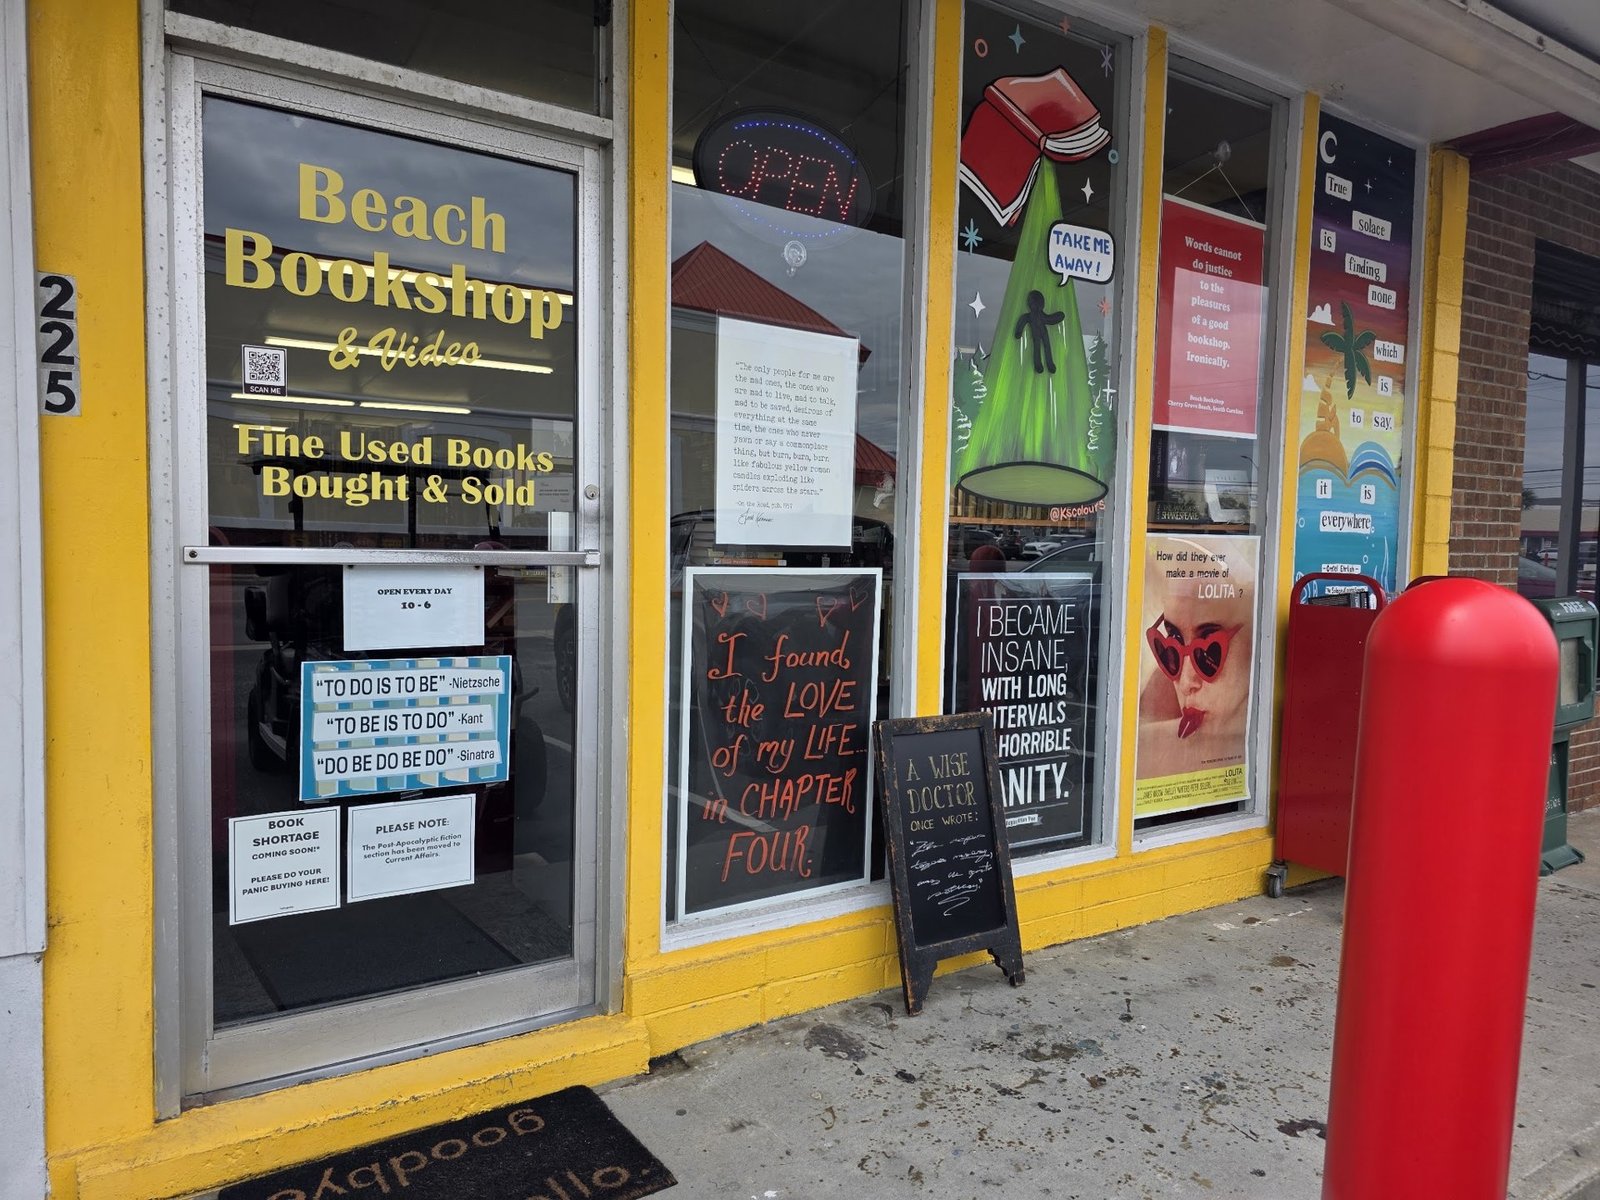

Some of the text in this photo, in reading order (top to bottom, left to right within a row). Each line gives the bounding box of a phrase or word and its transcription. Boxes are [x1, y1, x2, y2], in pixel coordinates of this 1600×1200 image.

[718, 139, 859, 221] OPEN
[1328, 176, 1348, 196] True
[298, 162, 506, 254] Beach
[1358, 217, 1386, 236] solace
[1053, 230, 1110, 255] TAKE ME
[1184, 236, 1242, 261] Words cannot
[1323, 231, 1333, 248] is
[1192, 258, 1233, 277] do justice
[1348, 256, 1381, 281] finding
[225, 227, 563, 339] Bookshop
[1199, 280, 1225, 294] to the
[1191, 296, 1231, 312] pleasures
[1191, 314, 1229, 330] of a good
[328, 327, 482, 372] & Video
[1187, 332, 1231, 351] bookshop.
[1186, 351, 1230, 369] Ironically.
[1375, 344, 1398, 359] which
[754, 365, 770, 375] only
[773, 368, 796, 378] people
[822, 374, 835, 382] are
[250, 385, 269, 393] SCAN
[735, 374, 747, 383] the
[749, 376, 763, 385] mad
[785, 381, 796, 389] the
[798, 383, 814, 391] ones
[816, 385, 829, 393] who
[1380, 378, 1389, 393] is
[734, 411, 776, 423] everything
[777, 415, 786, 423] at
[802, 419, 817, 427] same
[1352, 411, 1362, 423] to
[237, 424, 554, 473] Fine Used Books
[262, 466, 535, 507] Bought & Sold
[1320, 481, 1372, 500] it is
[1321, 514, 1371, 531] everywhere
[1156, 551, 1226, 563] How did they ever
[1166, 568, 1186, 578] make
[1197, 568, 1219, 578] movie
[1222, 568, 1229, 578] of
[1198, 584, 1235, 599] LOLITA
[401, 601, 415, 609] 10
[424, 601, 432, 609] 6
[1558, 601, 1586, 613] FREE
[977, 604, 1076, 637] I BECAME
[707, 629, 851, 683] I found
[981, 639, 1068, 673] INSANE,
[350, 678, 372, 695] DO
[377, 677, 391, 694] IS
[395, 676, 415, 693] TO
[981, 673, 1067, 701] WITH LONG
[720, 678, 857, 728] the LOVE
[361, 715, 380, 733] BE
[384, 714, 398, 732] IS
[402, 713, 422, 731] TO
[981, 701, 1066, 730] TERVALS
[998, 728, 1072, 758] HORRIBLE
[352, 754, 372, 772] BE
[376, 752, 399, 770] DO
[402, 751, 421, 768] BE
[712, 733, 749, 778] of
[756, 738, 795, 774] my
[906, 752, 970, 782] A WISE
[1225, 768, 1243, 778] LOLITA
[702, 767, 857, 824] in CHAPTER
[907, 781, 977, 814] DOCTOR
[268, 818, 304, 830] BOOK
[375, 822, 415, 834] PLEASE
[910, 819, 935, 832] ONCE
[252, 831, 320, 847] SHORTAGE
[377, 836, 439, 850] Post-Apocalyptic
[252, 850, 287, 860] COMING
[363, 850, 390, 859] section
[427, 841, 452, 850] moved
[385, 852, 440, 864] Current Affairs.
[251, 868, 322, 883] PLEASE DO YOUR
[242, 877, 330, 896] PANIC BUYING HERE!
